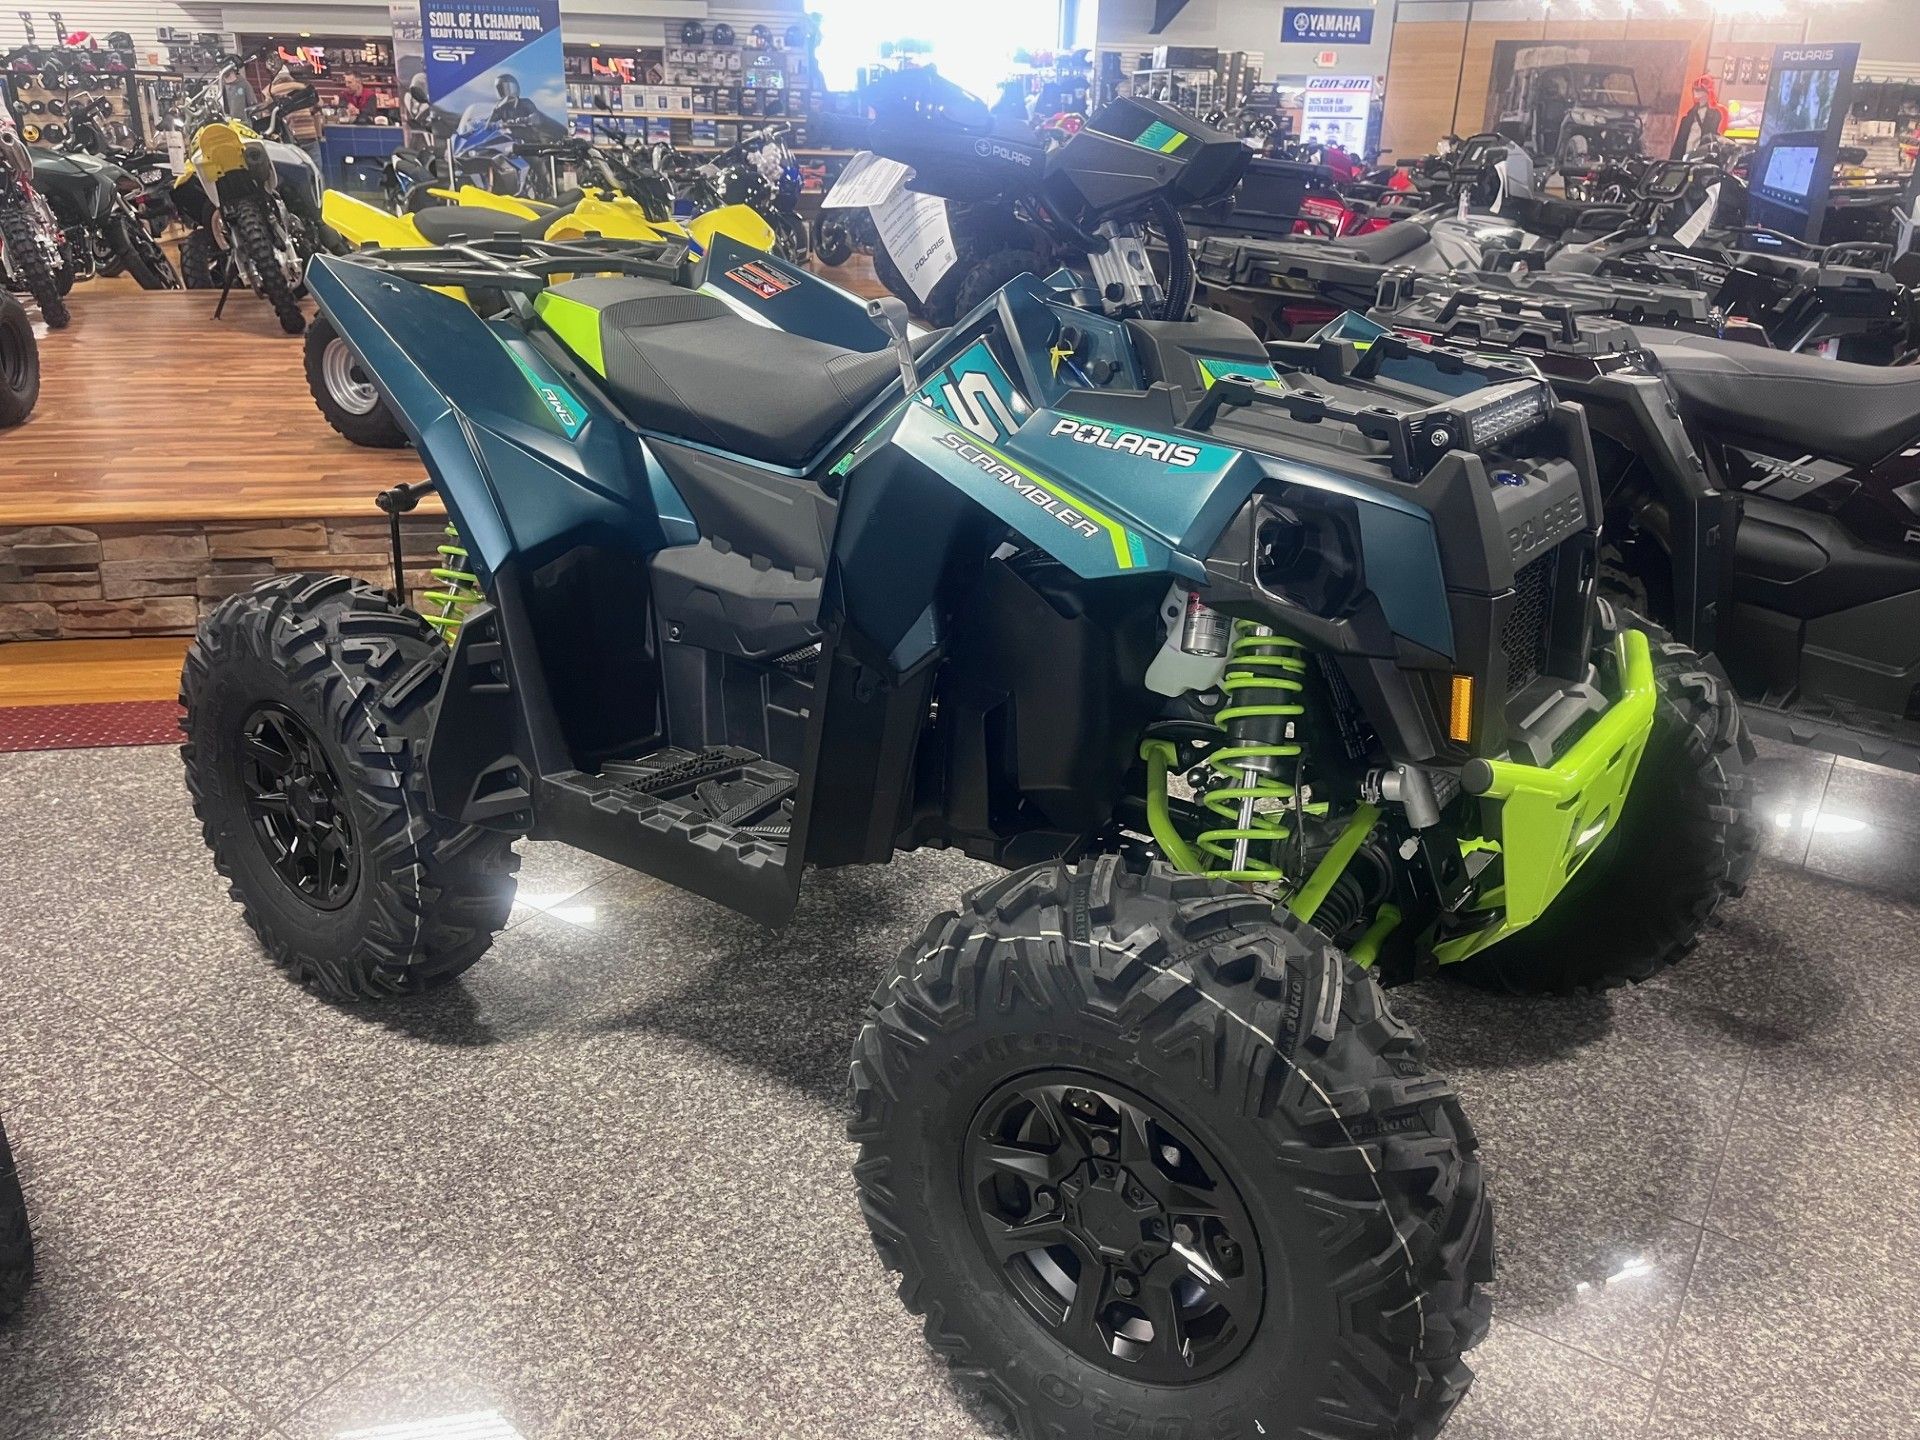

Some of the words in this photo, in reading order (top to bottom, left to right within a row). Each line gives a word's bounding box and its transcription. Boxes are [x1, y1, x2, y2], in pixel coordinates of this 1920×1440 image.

[428, 12, 457, 27] SOUL
[459, 14, 471, 28] OF
[473, 16, 482, 29] A
[483, 16, 543, 32] CHAMPION,
[1310, 14, 1361, 32] YAMAHA
[430, 28, 452, 39] READY
[454, 30, 464, 39] TO
[464, 30, 475, 40] GO
[475, 31, 488, 40] THE
[489, 31, 525, 41] DISTANCE.
[1783, 50, 1834, 61] POLARIS
[1308, 79, 1370, 89] can-am
[992, 145, 1032, 167] POLARIS
[914, 236, 945, 272] POLARIS
[541, 388, 576, 426] AWD
[1051, 417, 1202, 469] POLARIS
[1750, 460, 1816, 484] AWD
[932, 432, 1099, 539] SCRAMBLER
[1507, 493, 1582, 560] POLARIS
